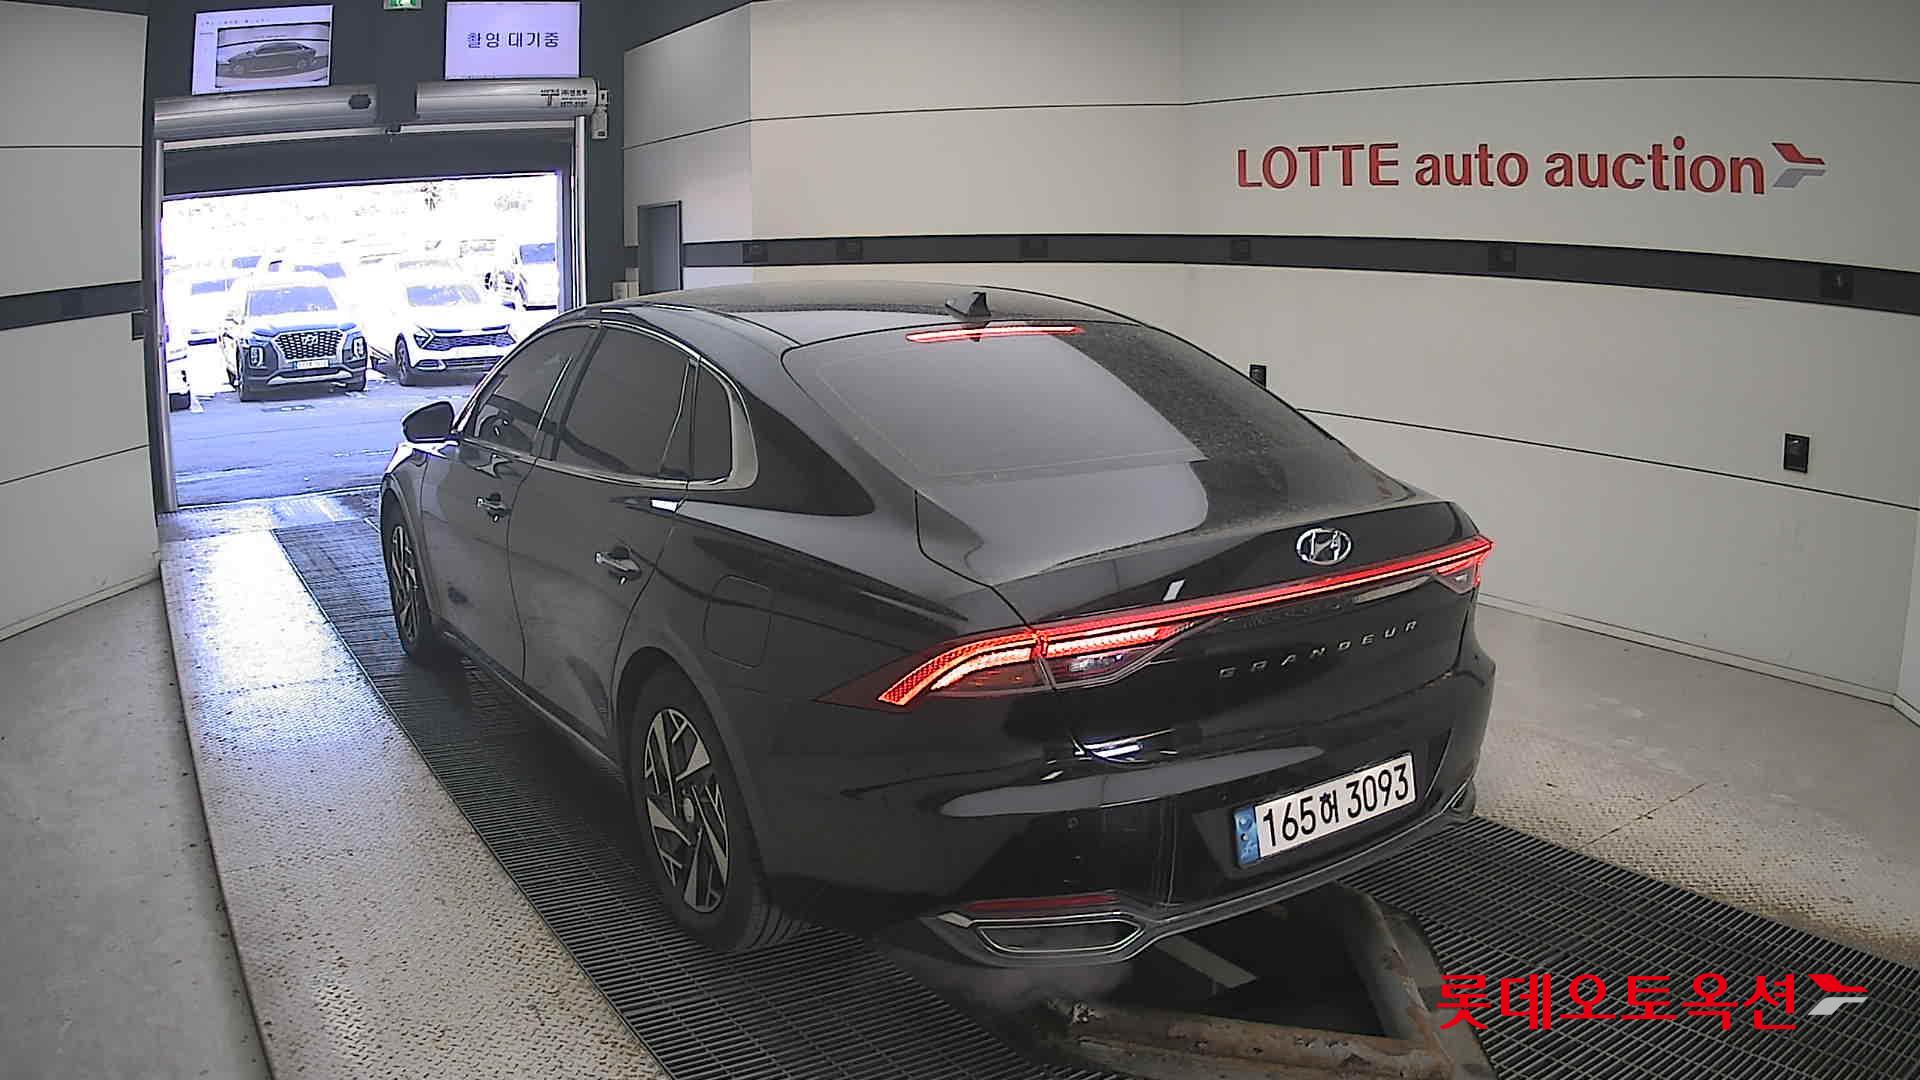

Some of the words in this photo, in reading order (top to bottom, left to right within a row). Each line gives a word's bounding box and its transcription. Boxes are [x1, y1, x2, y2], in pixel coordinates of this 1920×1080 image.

[507, 31, 560, 48] 대기중
[1237, 144, 1399, 189] LOTTE
[1414, 143, 1529, 187] auto
[1544, 136, 1765, 194] auction
[1218, 619, 1418, 678] GRANDEUR
[1262, 788, 1340, 847] 165허
[1345, 762, 1410, 819] 3093
